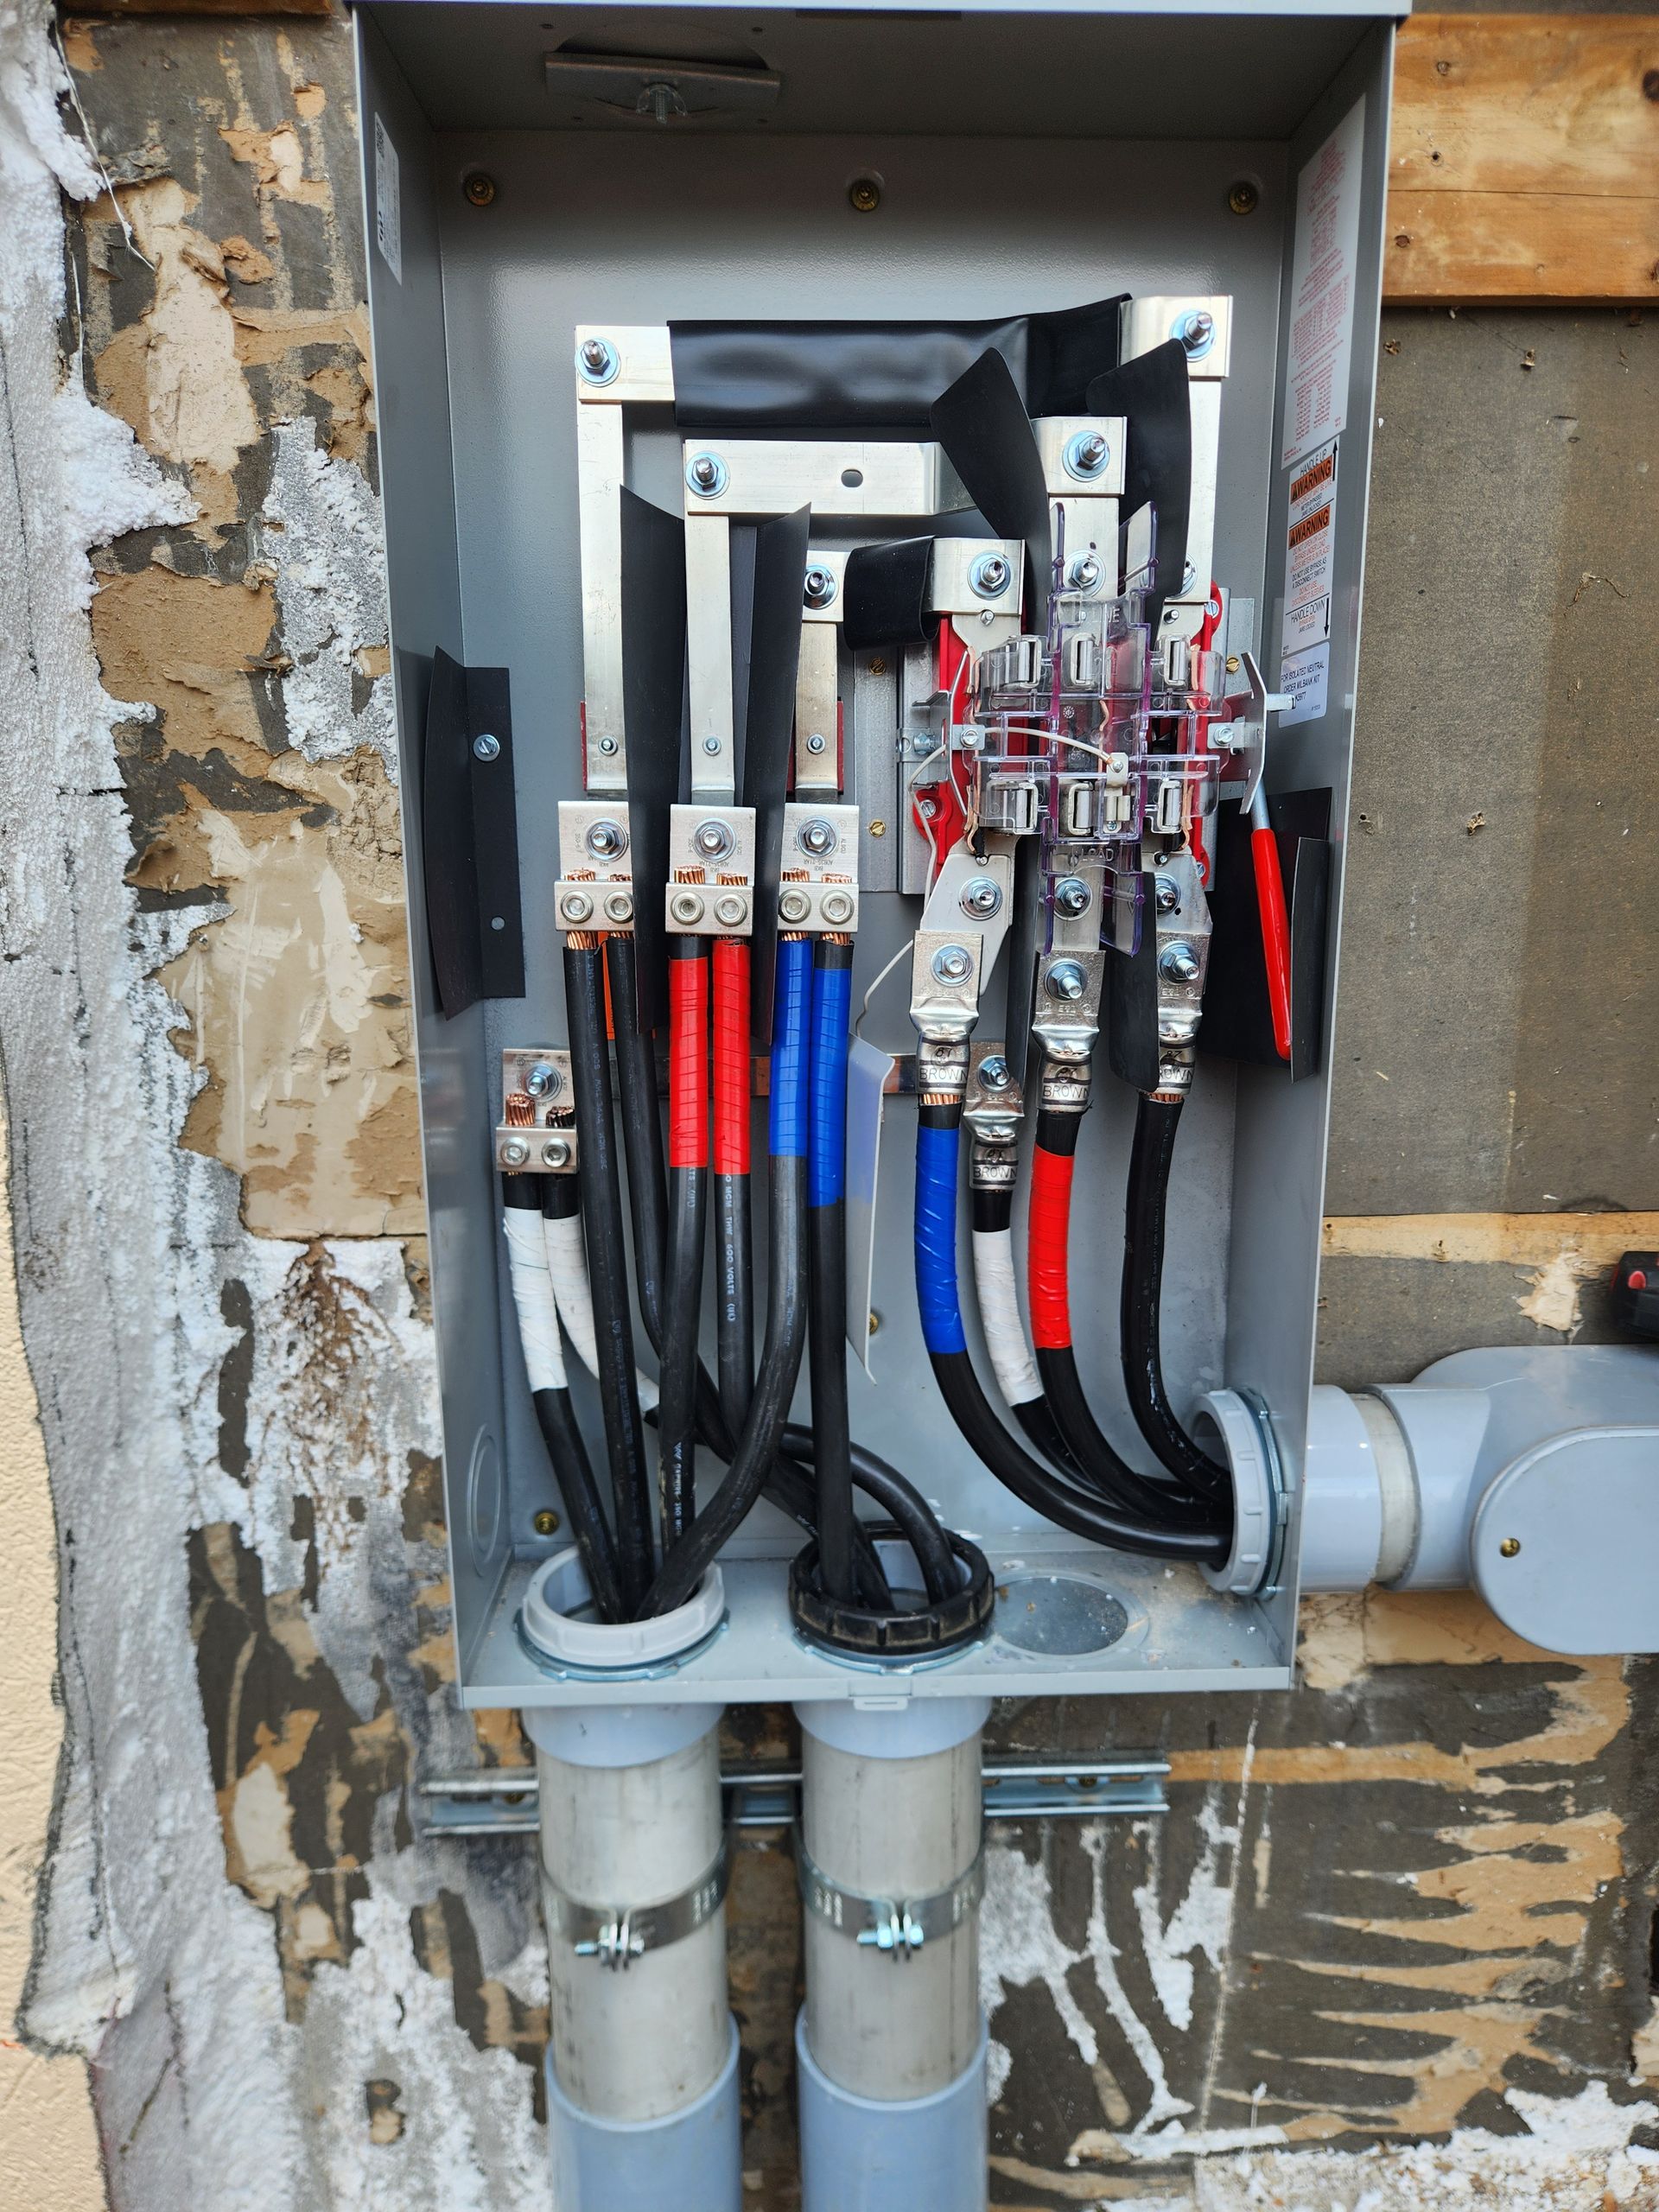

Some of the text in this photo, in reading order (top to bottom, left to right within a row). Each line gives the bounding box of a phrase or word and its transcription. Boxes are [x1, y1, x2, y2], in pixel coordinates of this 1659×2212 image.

[1297, 458, 1331, 497] WARNING
[1295, 507, 1329, 543] WARNING
[1291, 600, 1325, 623] HANDLE DOWN
[1289, 666, 1306, 679] ISOLATED
[1306, 659, 1325, 673] NEUTRAL
[1283, 683, 1296, 693] ORDER
[1081, 848, 1115, 862] LOAD
[919, 1068, 968, 1080] BROWN
[1159, 1068, 1194, 1081] ROWN
[1043, 1085, 1090, 1098] BROWN
[974, 1167, 1017, 1179] BROWN
[726, 1267, 734, 1295] VOLTS
